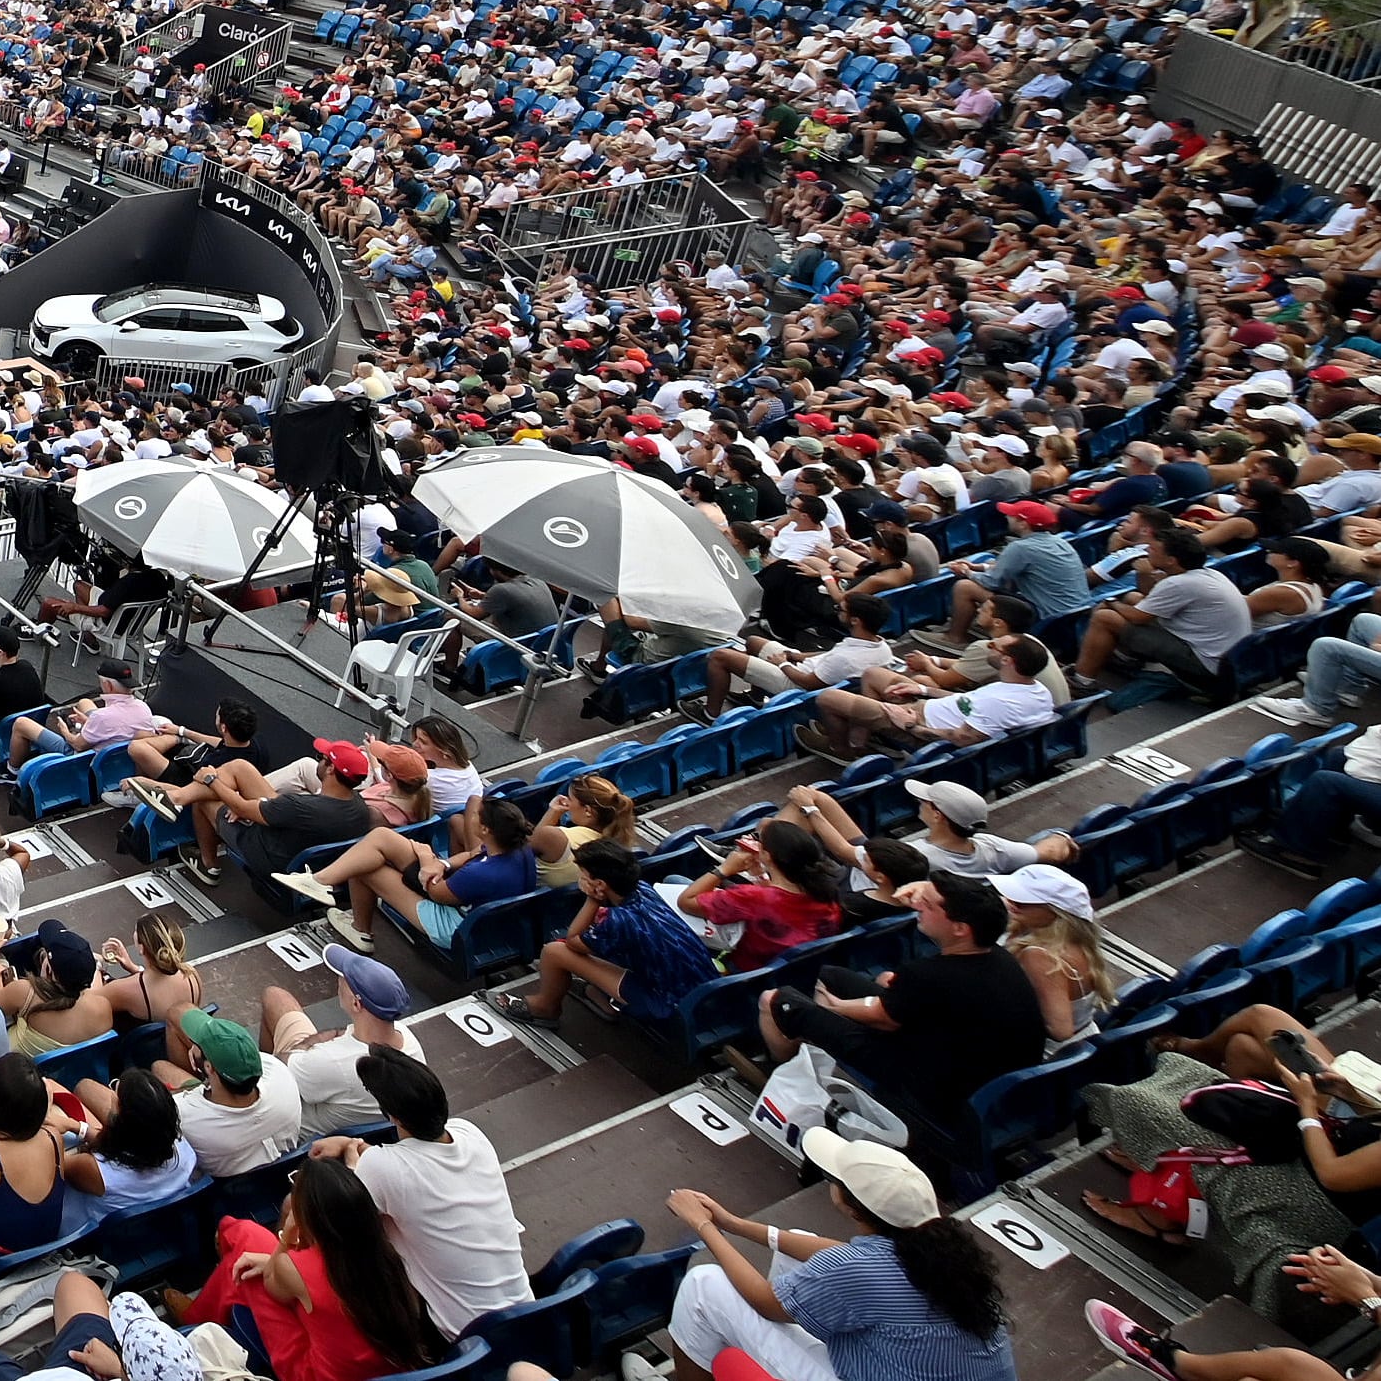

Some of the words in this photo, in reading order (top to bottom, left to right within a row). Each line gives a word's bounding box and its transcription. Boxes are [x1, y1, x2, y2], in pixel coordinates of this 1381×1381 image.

[218, 22, 258, 43] Claro
[21, 838, 38, 851] L
[135, 882, 164, 902] M
[279, 941, 301, 963] N
[463, 1013, 494, 1036] O
[697, 1103, 730, 1132] P
[991, 1219, 1041, 1251] Q
